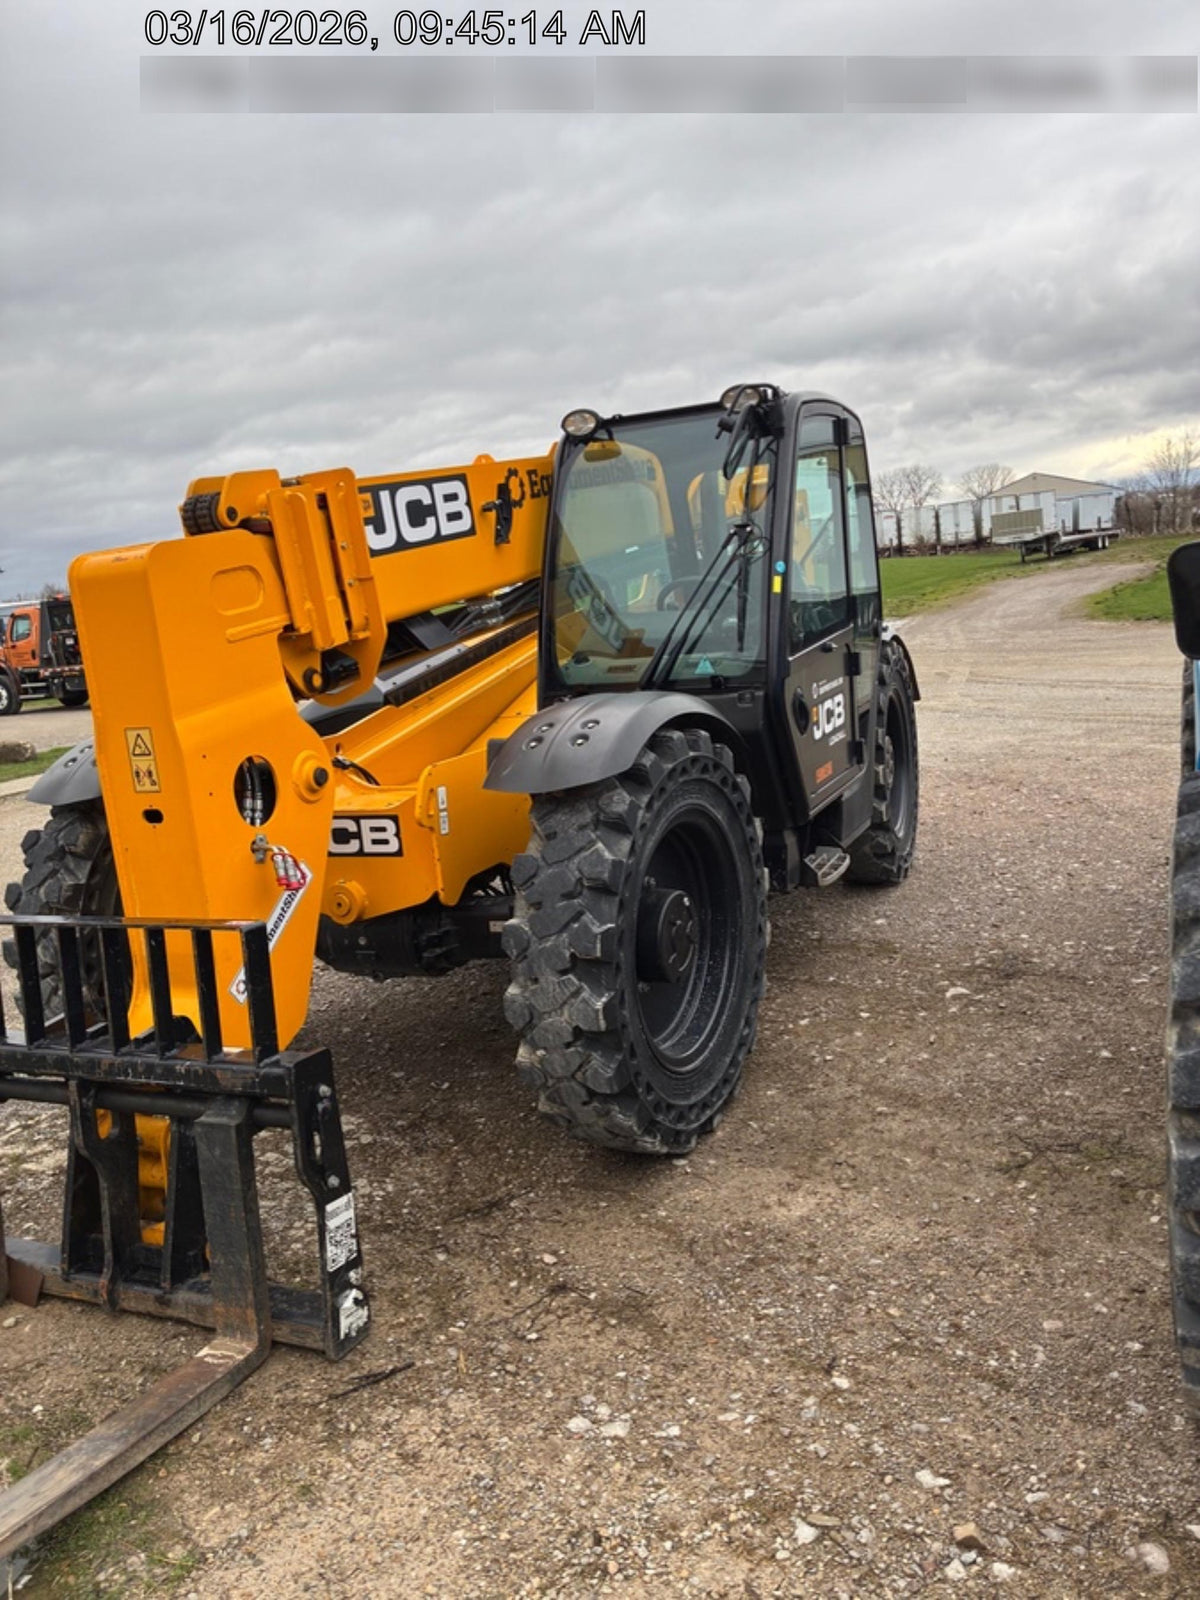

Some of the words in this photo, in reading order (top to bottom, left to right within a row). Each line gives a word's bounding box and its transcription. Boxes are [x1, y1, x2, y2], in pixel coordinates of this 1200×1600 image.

[364, 479, 473, 551] JCB
[813, 693, 846, 740] JCB
[328, 818, 400, 854] CB
